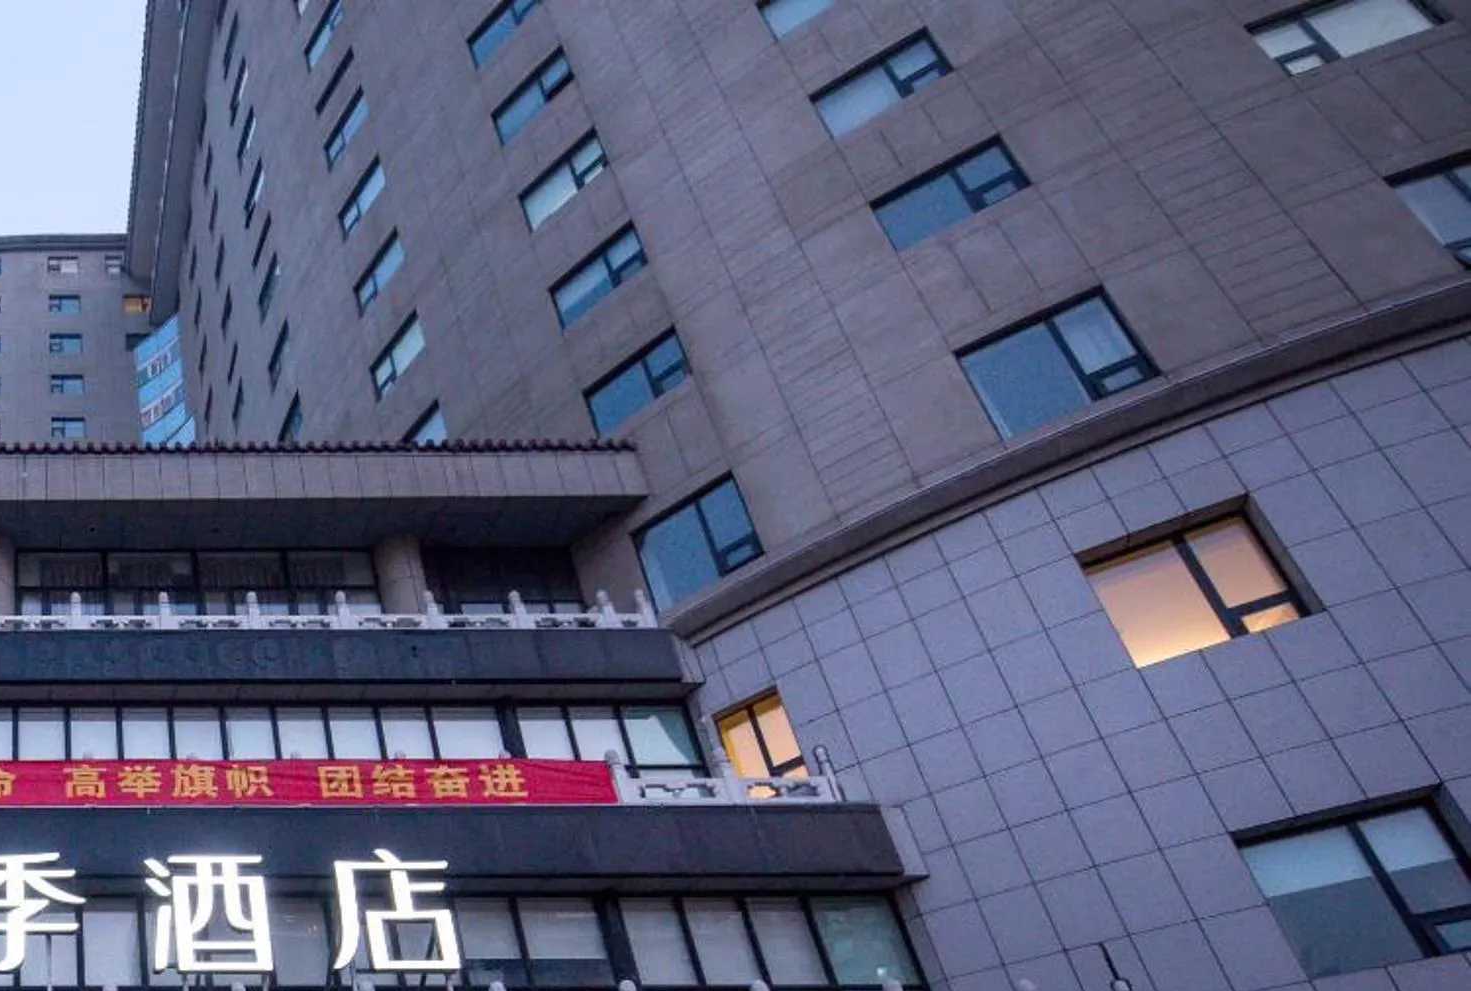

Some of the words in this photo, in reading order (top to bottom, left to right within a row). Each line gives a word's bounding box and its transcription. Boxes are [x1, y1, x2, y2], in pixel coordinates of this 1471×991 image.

[63, 763, 274, 798] 高举旗帜
[318, 763, 529, 798] 团结奋进
